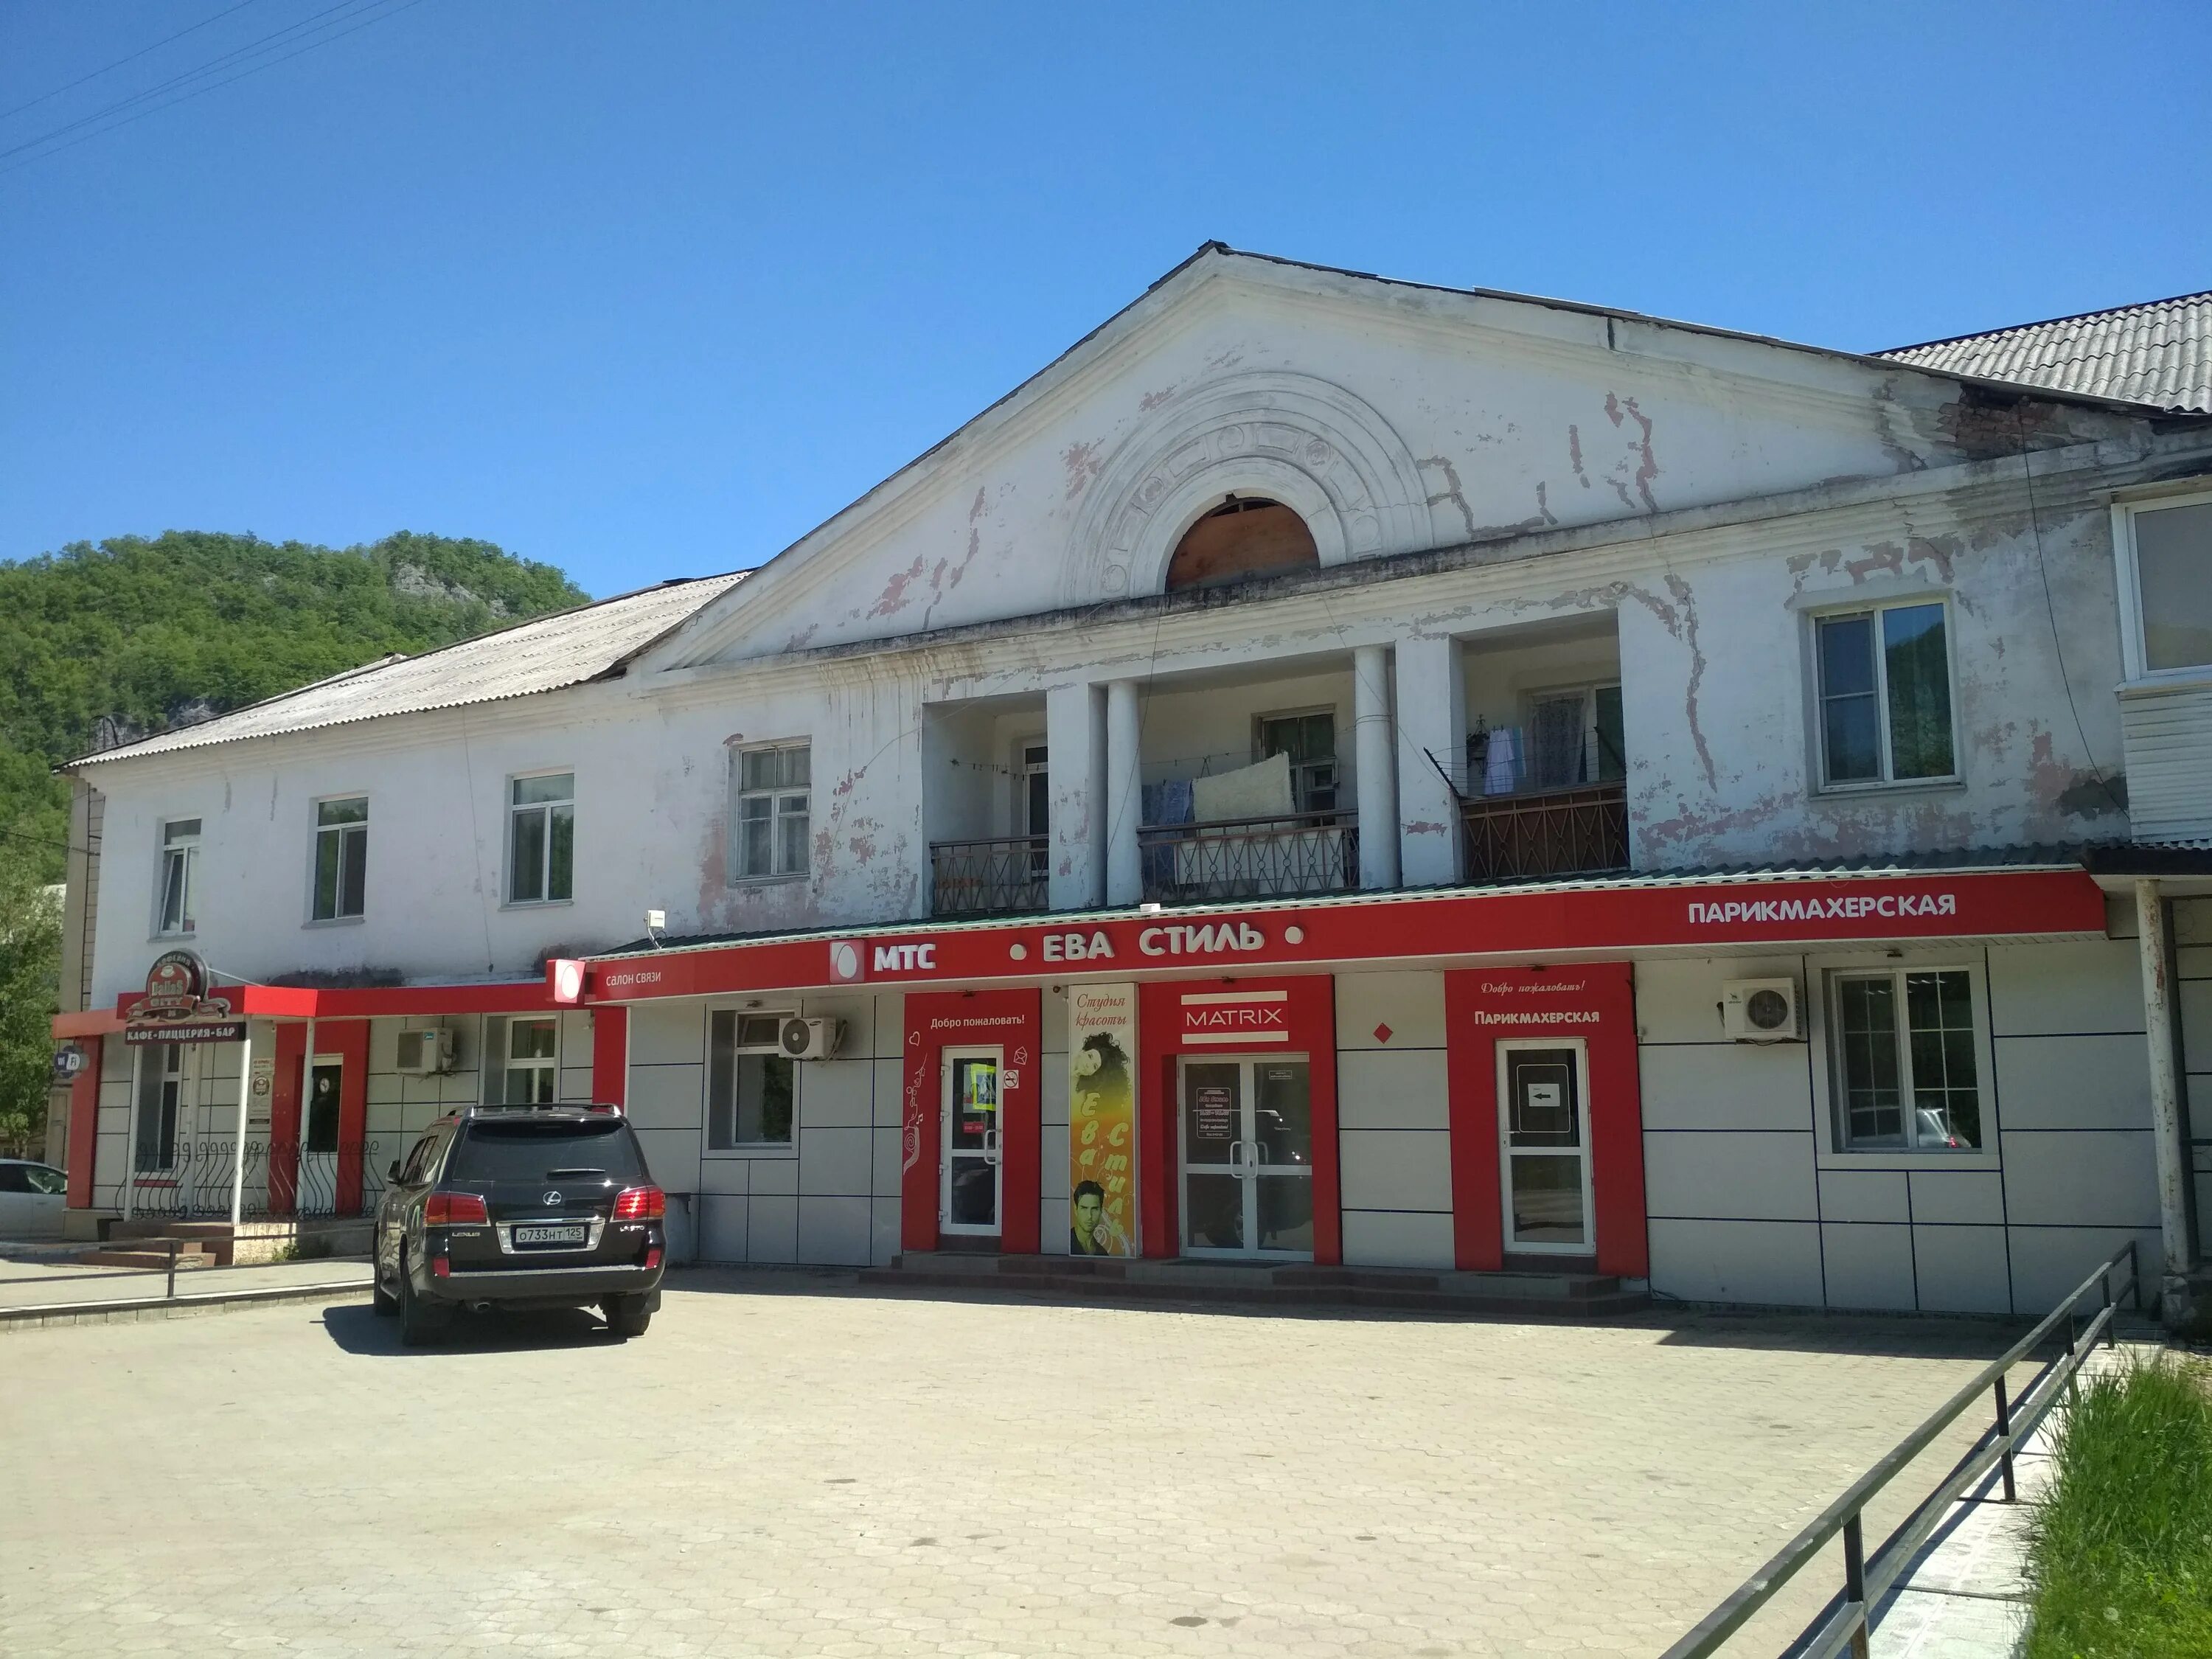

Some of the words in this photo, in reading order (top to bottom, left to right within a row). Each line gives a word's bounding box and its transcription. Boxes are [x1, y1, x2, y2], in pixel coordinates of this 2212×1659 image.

[1688, 894, 1957, 924] ПАРИКМАХЕРСКАЯ
[1043, 931, 1115, 961] ЕВА
[1139, 922, 1265, 956] СТИЛЬ
[874, 943, 936, 972] МТС
[606, 975, 633, 987] салон
[636, 971, 661, 984] связи
[1481, 982, 1513, 995] Добро
[1518, 980, 1586, 994] пожаловать!
[1077, 993, 1125, 1012] Студия
[931, 1017, 961, 1029] Добро
[963, 1014, 1025, 1027] пожаловать!
[1075, 1011, 1127, 1030] красоты
[1186, 1008, 1282, 1026] MATRIX
[58, 1056, 66, 1066] Wi
[565, 1228, 582, 1237] 125
